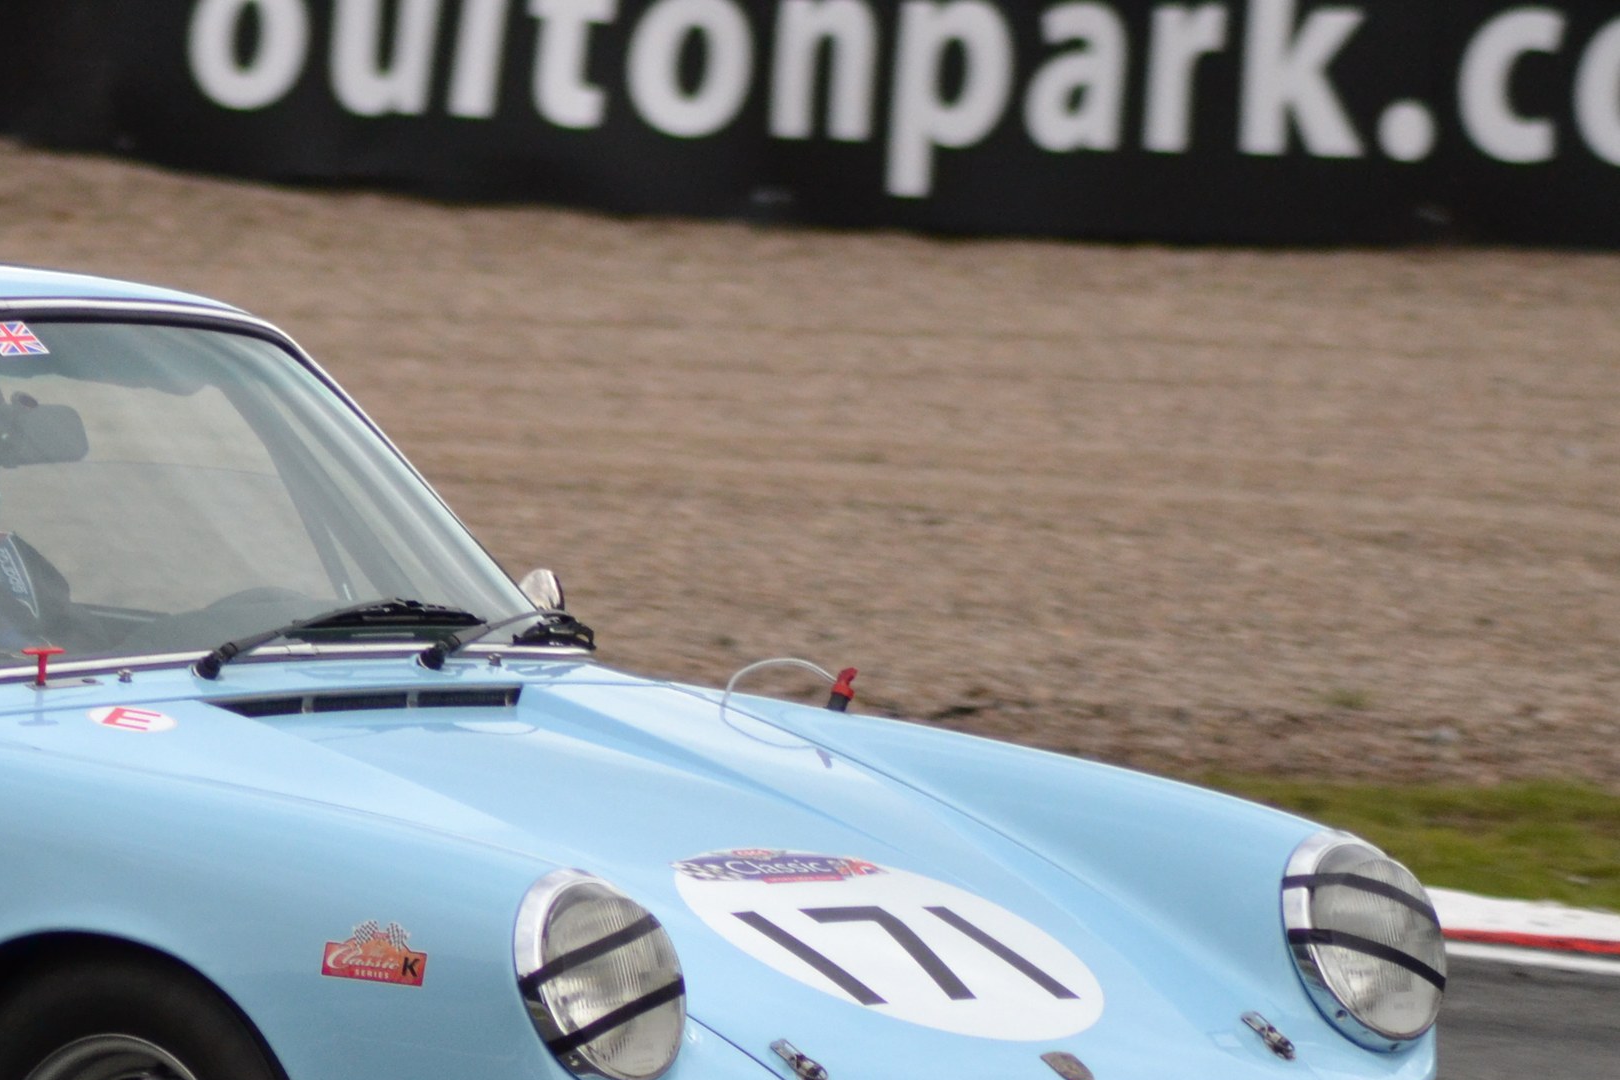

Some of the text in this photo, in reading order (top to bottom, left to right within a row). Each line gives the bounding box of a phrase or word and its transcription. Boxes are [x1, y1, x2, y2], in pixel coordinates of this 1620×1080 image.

[102, 707, 161, 731] E
[725, 858, 831, 876] Classic
[326, 944, 400, 970] Classic
[402, 956, 421, 978] K
[730, 905, 1081, 1006] 171
[355, 968, 390, 980] SERIES
